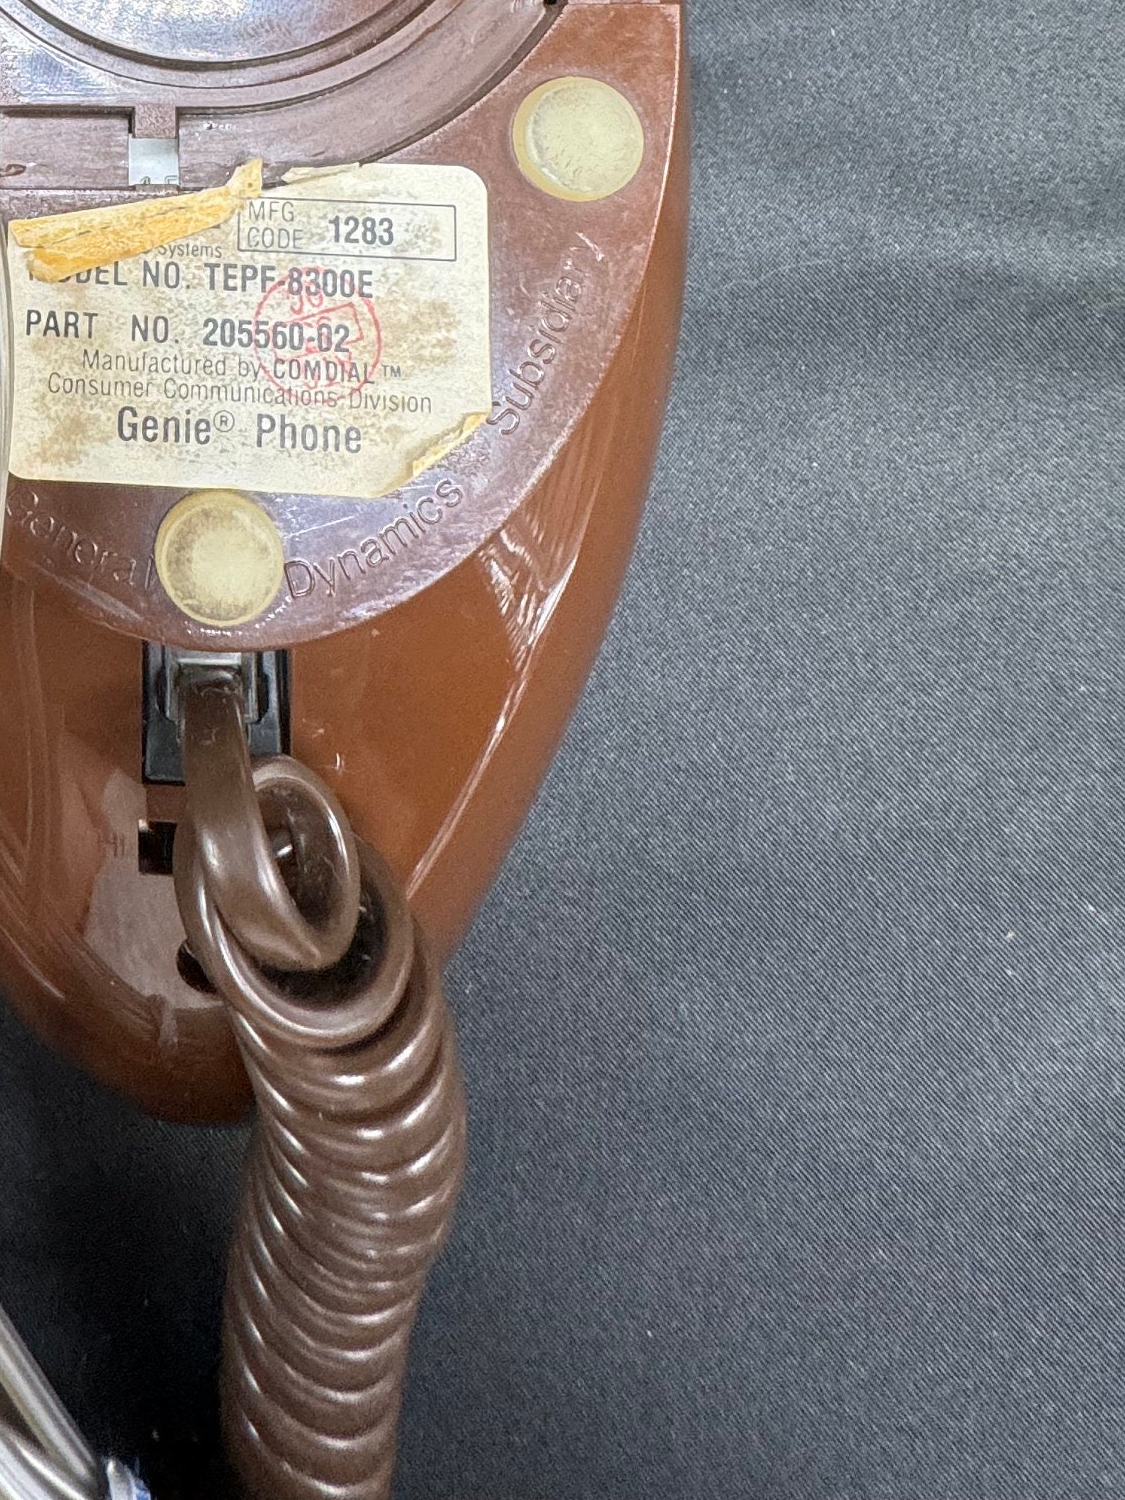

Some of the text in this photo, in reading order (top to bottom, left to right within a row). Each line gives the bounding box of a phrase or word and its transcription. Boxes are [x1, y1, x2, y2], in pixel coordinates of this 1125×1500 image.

[248, 202, 296, 222] MFG
[246, 215, 395, 250] CODE 1283
[29, 259, 374, 299] DEL NO. TEPF-8300E
[26, 309, 351, 353] PART NO. 205560-02
[82, 350, 227, 378] Manufactured
[237, 354, 262, 382] by
[273, 358, 375, 385] COMDIAL
[48, 373, 433, 414] Consumer Communications Division
[256, 415, 363, 454] Phone
[283, 478, 465, 600] Dynamics
